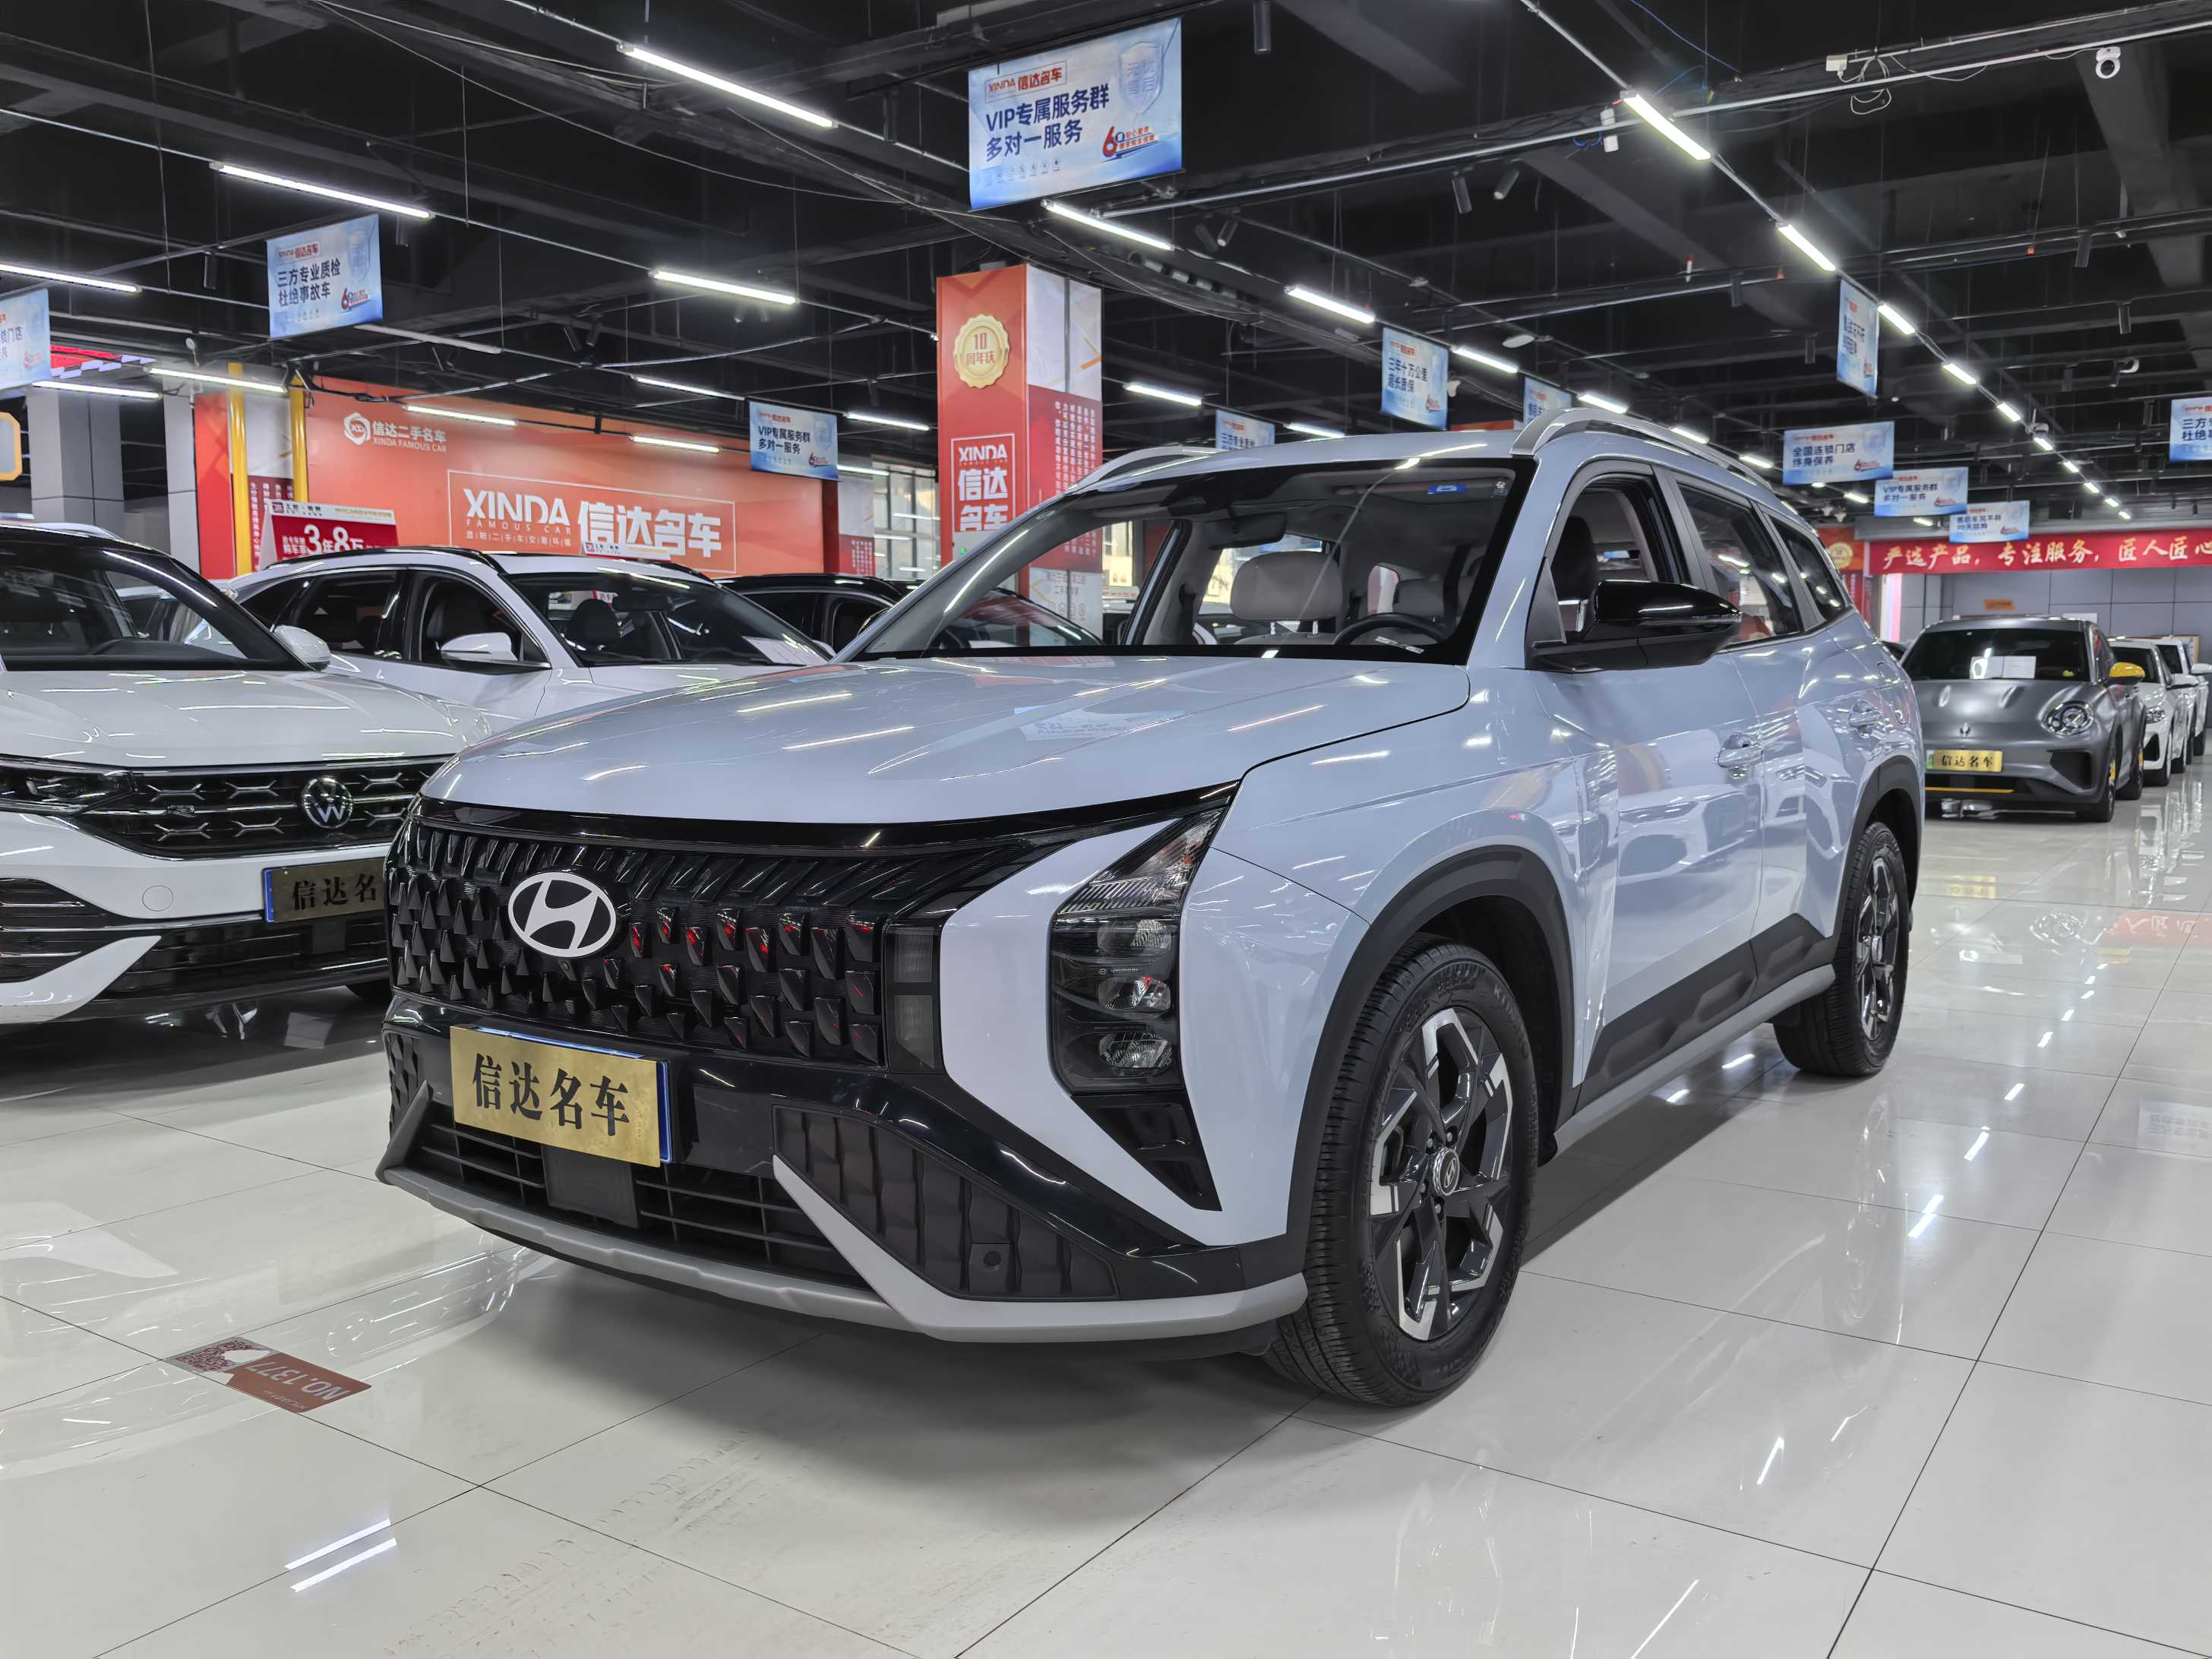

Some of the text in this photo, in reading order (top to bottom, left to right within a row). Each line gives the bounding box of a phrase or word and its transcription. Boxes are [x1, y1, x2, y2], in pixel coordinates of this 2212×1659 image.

[1019, 67, 1061, 90] 信达名车
[986, 84, 1109, 131] VIP专属服务群
[986, 119, 1082, 162] 多对一服务
[277, 258, 341, 287] 三方专业质检
[278, 281, 331, 307] 杜绝事故车
[974, 333, 987, 349] 10
[372, 421, 447, 443] 信达二手名车
[758, 425, 811, 444] VIP专属服务群
[2182, 418, 2212, 430] 三方
[2182, 429, 2212, 441] 杜绝
[759, 438, 801, 455] 多对一服务
[958, 444, 1008, 462] XINDA
[1792, 443, 1856, 457] 全国连锁门店
[958, 466, 1009, 501] 信达
[463, 488, 570, 526] XINDA
[466, 519, 571, 536] FAMOUS CAR
[578, 501, 722, 558] 信达名车
[1942, 754, 1994, 768] 信达名车
[292, 874, 377, 911] 信达名
[472, 1052, 630, 1136] 信达名车
[245, 1360, 351, 1401] NO.1377
